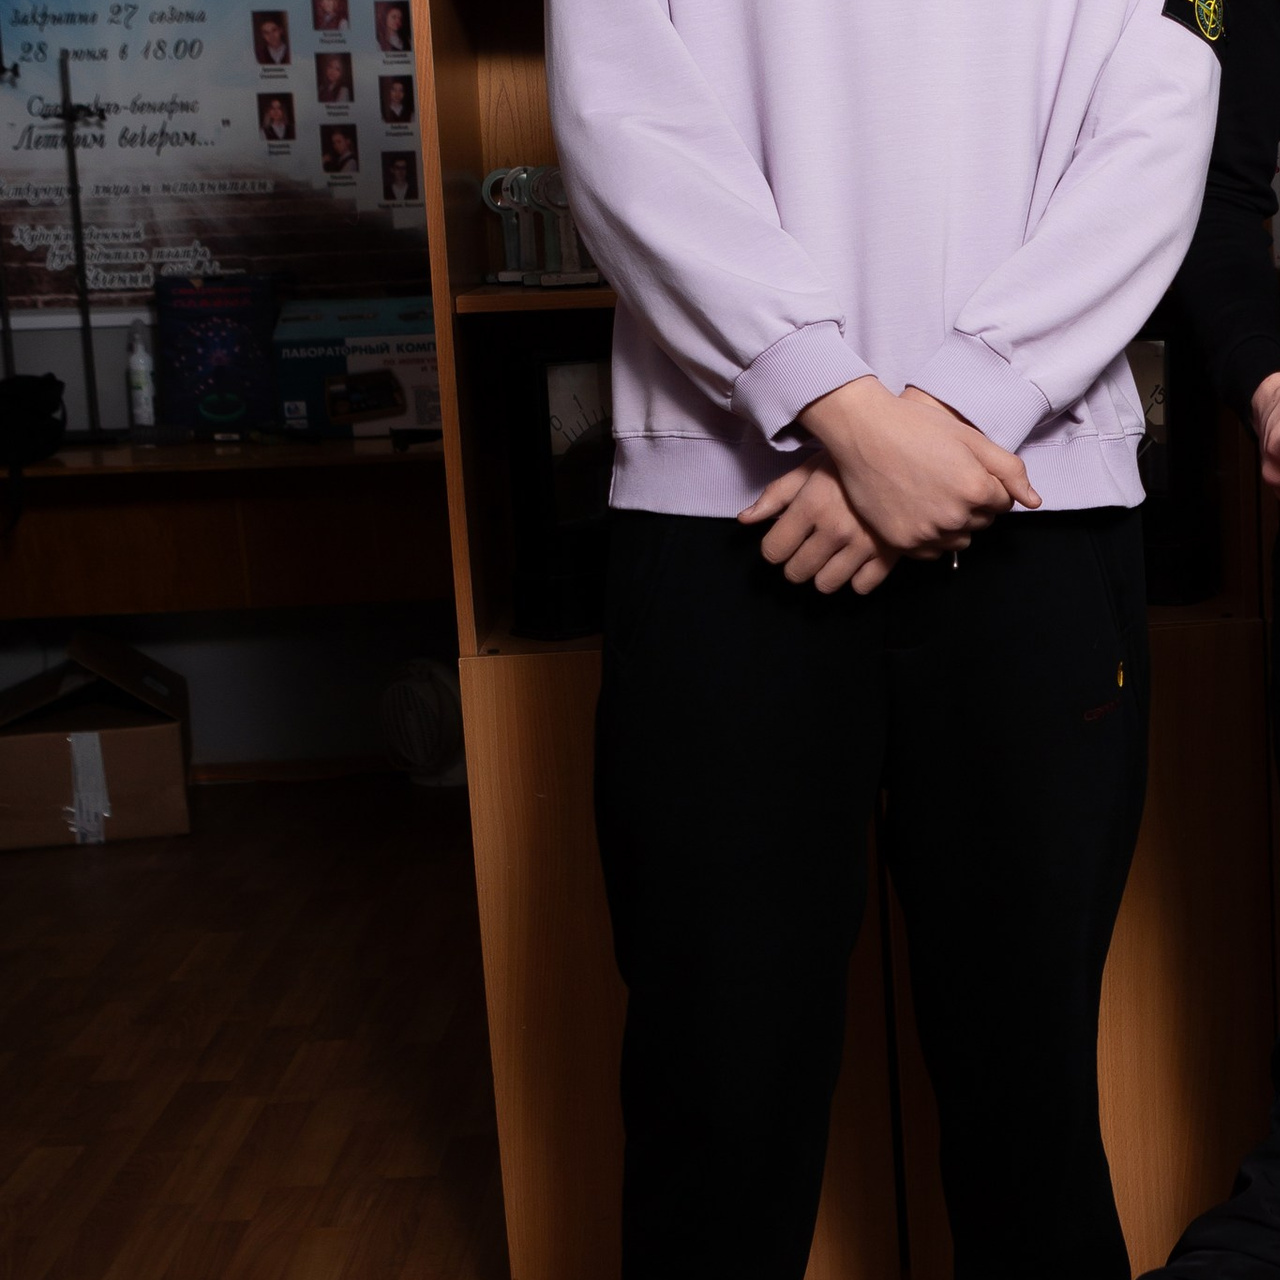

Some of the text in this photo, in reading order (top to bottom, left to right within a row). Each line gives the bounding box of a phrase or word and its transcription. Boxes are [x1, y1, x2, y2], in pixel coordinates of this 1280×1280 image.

[108, 2, 139, 30] 27
[20, 40, 48, 63] 28
[141, 38, 203, 62] 18.00
[281, 342, 390, 359] ЛАБОРАТОРНЫЙ
[1150, 384, 1166, 406] 15
